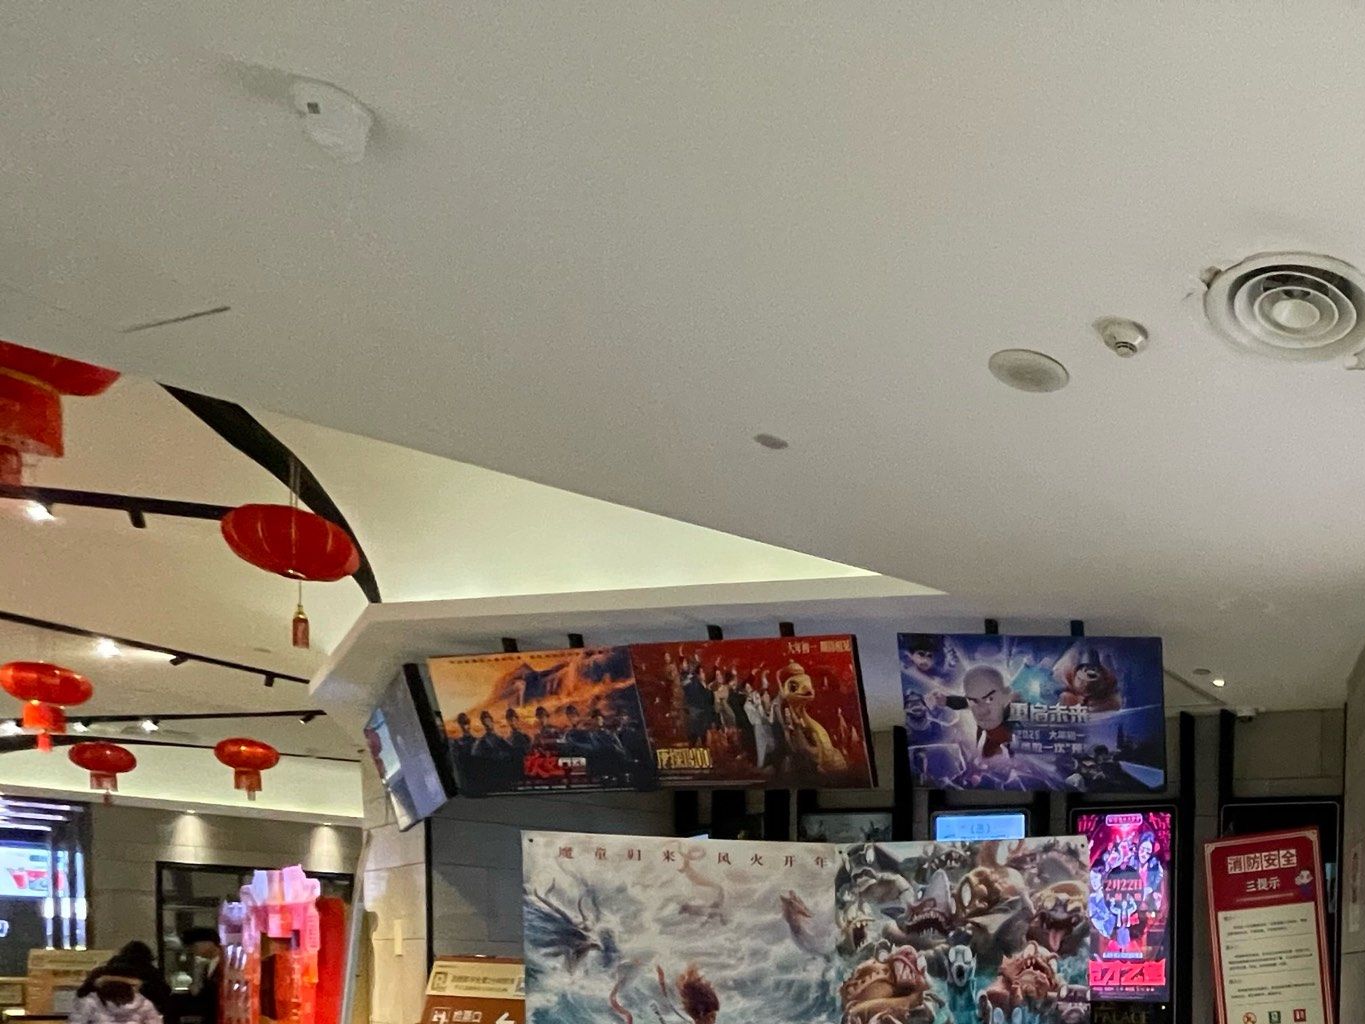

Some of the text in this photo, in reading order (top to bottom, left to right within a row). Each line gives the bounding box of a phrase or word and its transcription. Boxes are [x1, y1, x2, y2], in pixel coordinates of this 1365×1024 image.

[557, 846, 829, 868] 魔童归来 风火开年
[1228, 850, 1296, 874] 消防安全
[1245, 876, 1281, 892] 三提示
